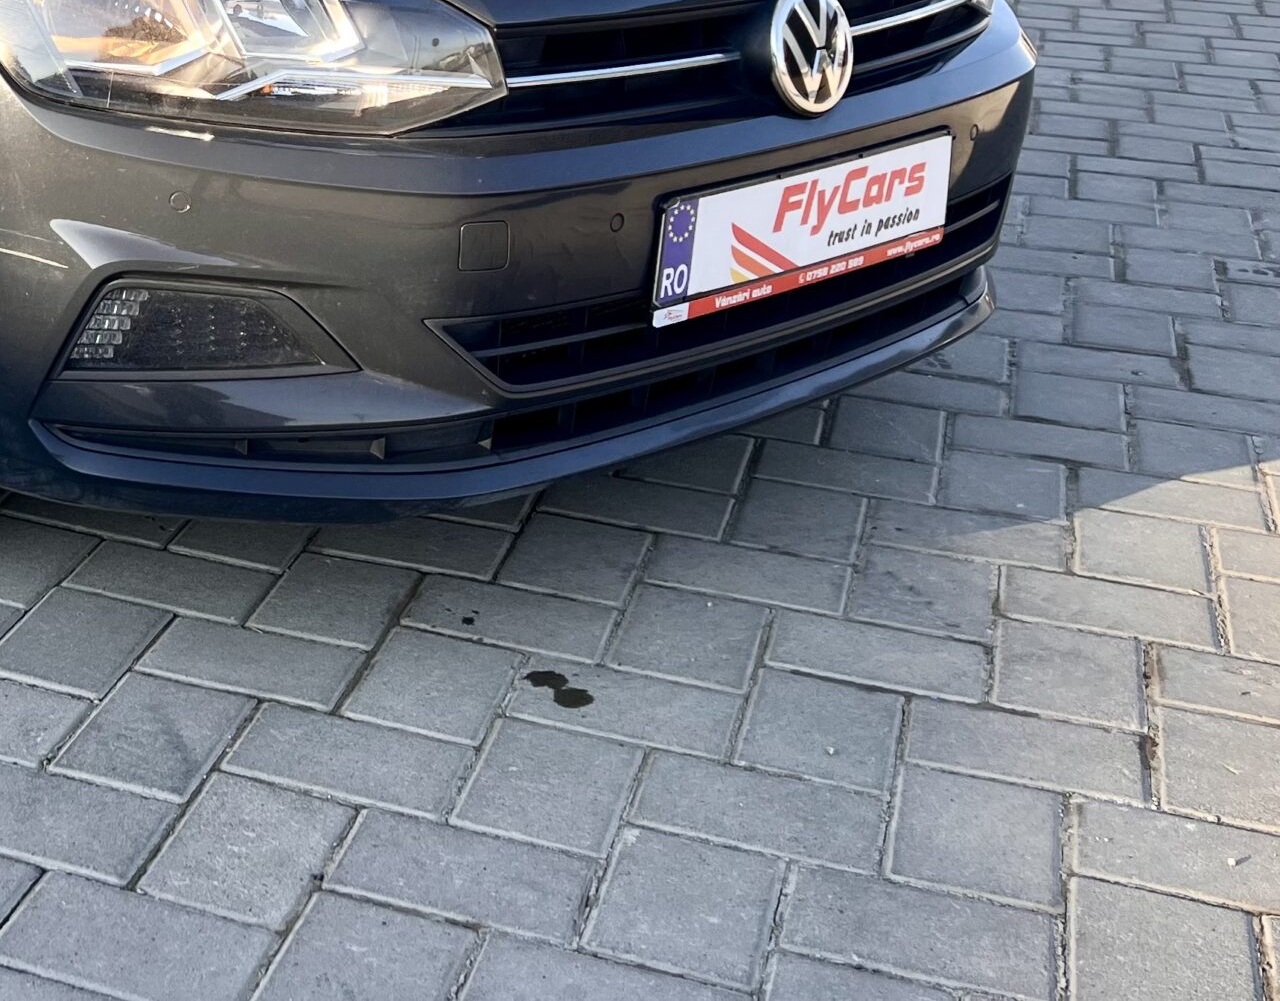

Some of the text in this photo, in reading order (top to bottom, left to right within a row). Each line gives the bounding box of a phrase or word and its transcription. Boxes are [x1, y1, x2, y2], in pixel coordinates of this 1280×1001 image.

[772, 162, 928, 237] FlyCars
[827, 206, 921, 247] trust in passion
[660, 264, 689, 299] RO
[751, 284, 773, 298] auto
